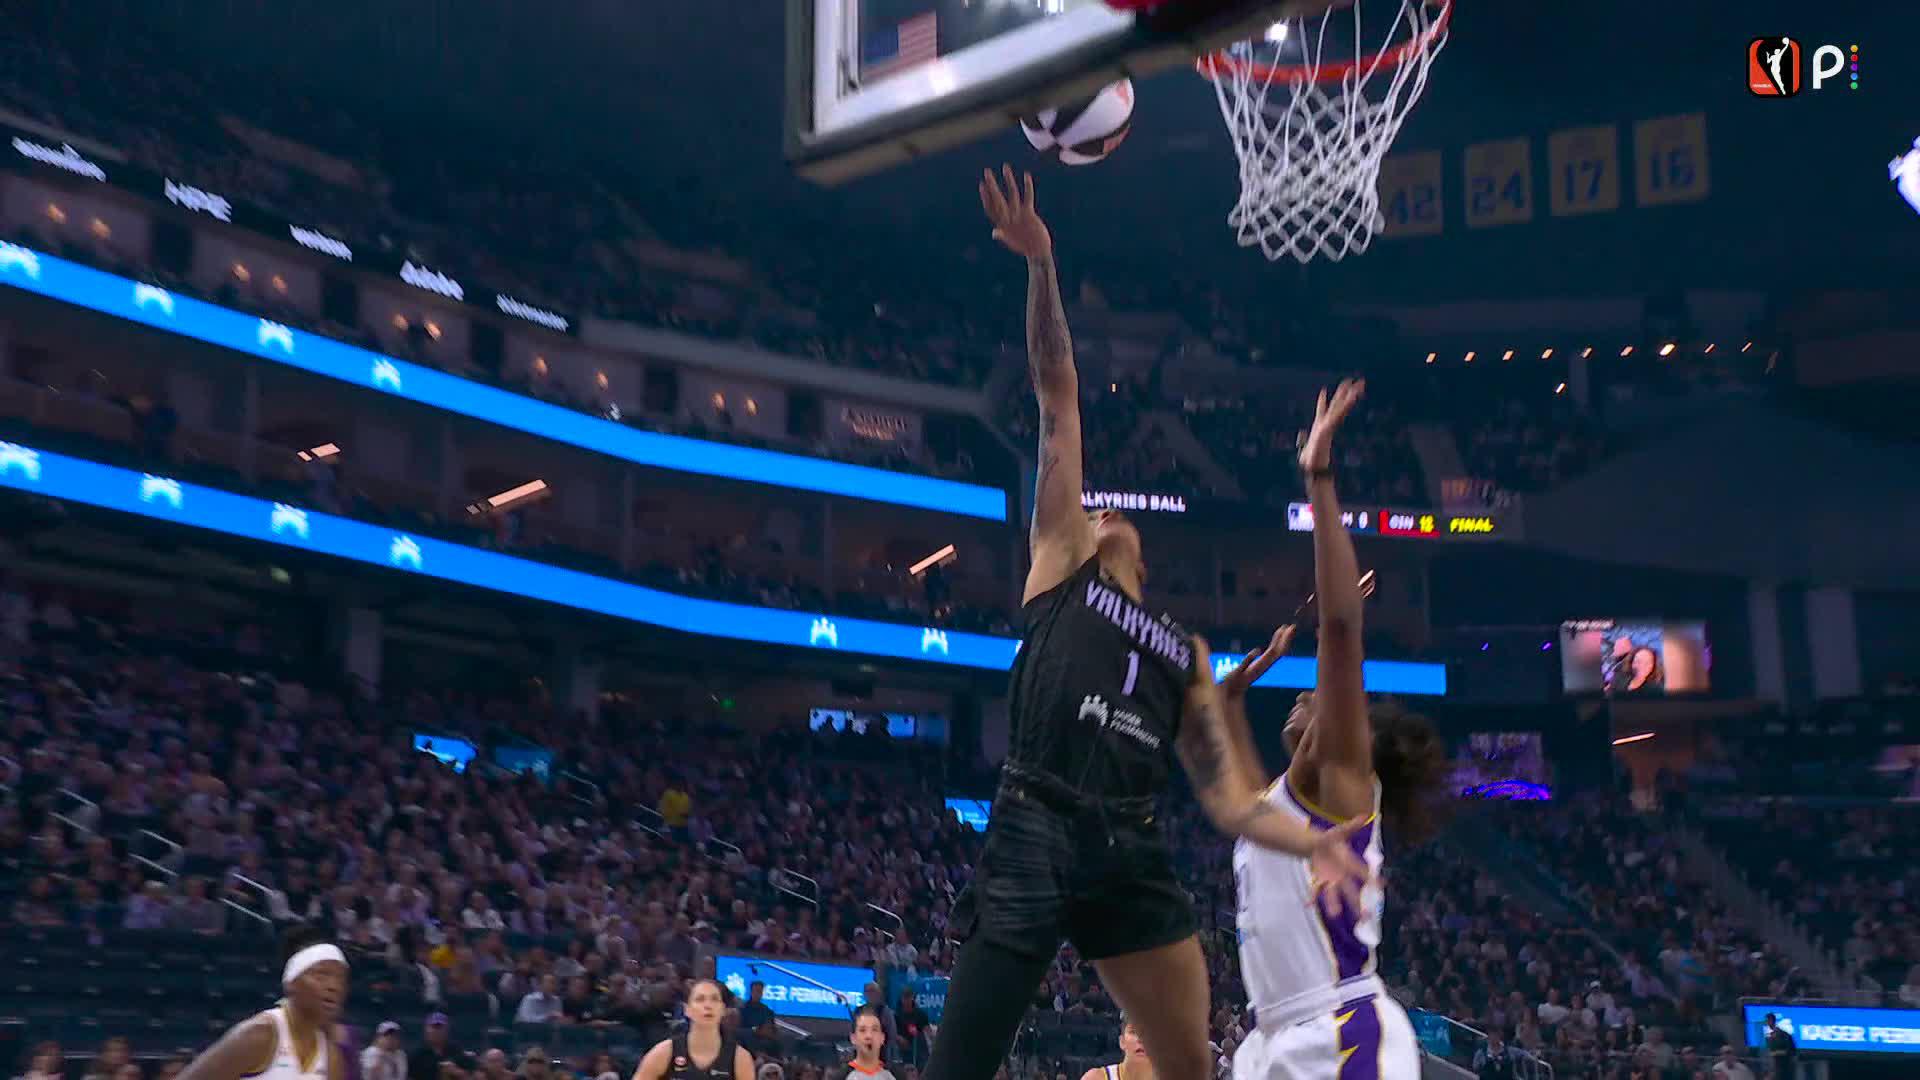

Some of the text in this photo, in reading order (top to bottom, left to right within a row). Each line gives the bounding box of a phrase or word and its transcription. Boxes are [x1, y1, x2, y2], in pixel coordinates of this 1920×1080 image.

[1471, 167, 1527, 216] 24
[1563, 159, 1606, 204] 17
[1081, 490, 1186, 512] ALKYRIES BALL
[1450, 517, 1494, 533] FINAL
[1085, 579, 1191, 671] VALKYRIES
[1121, 650, 1140, 697] 1
